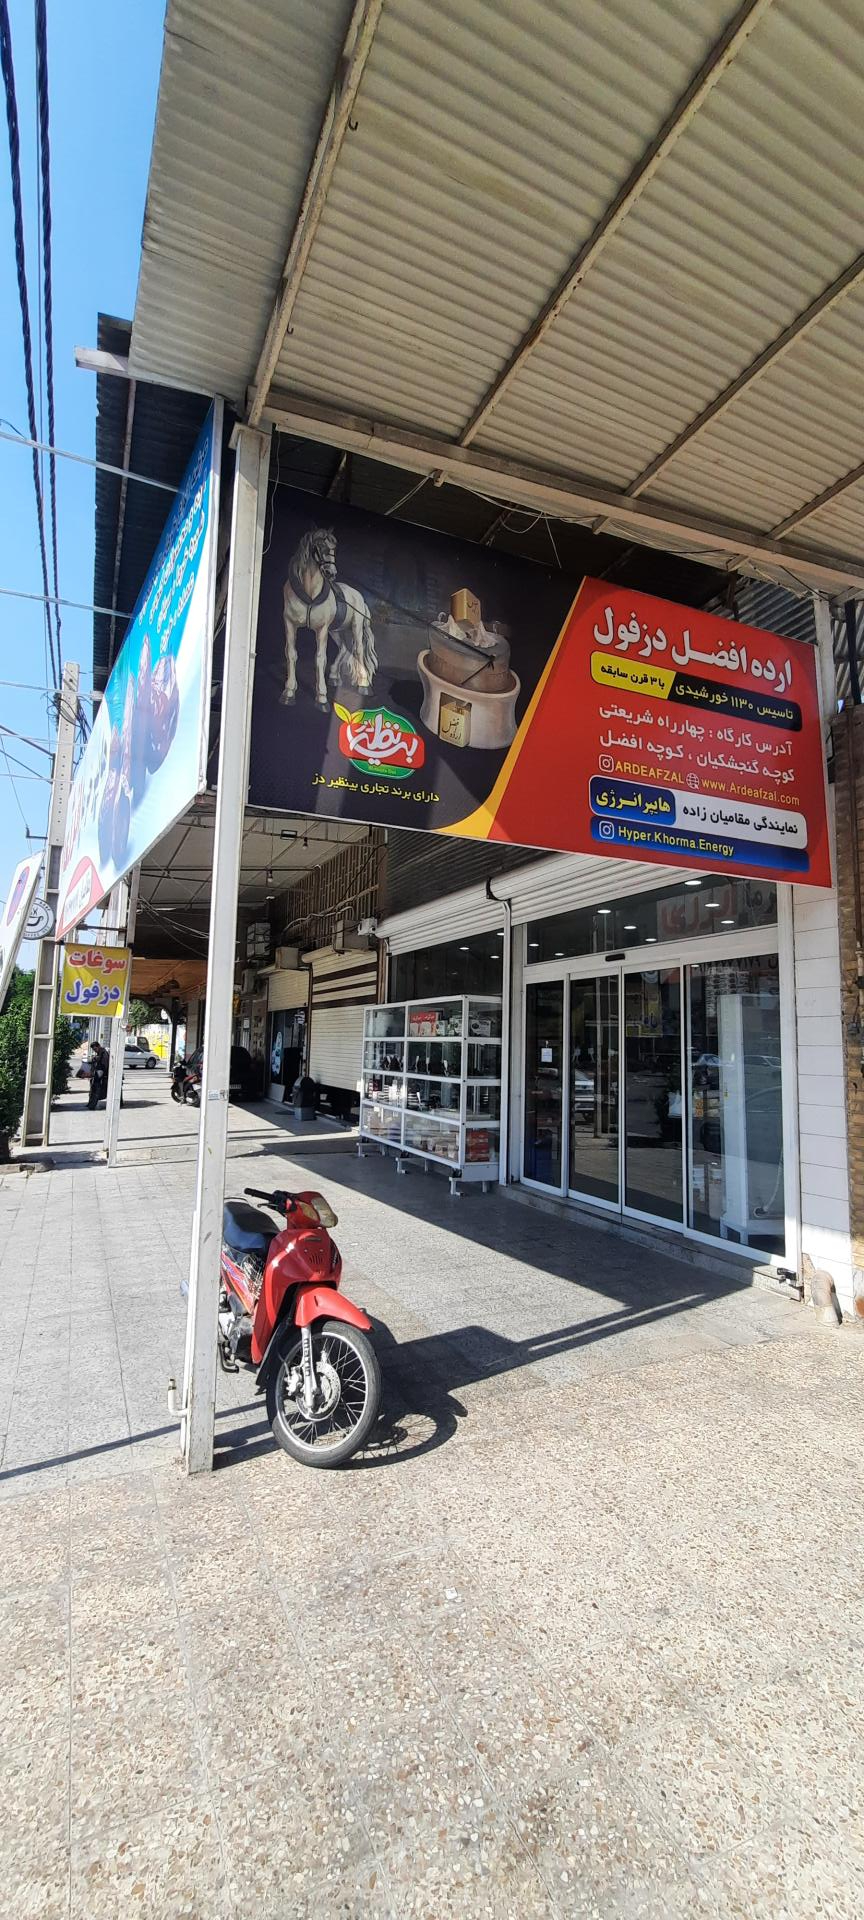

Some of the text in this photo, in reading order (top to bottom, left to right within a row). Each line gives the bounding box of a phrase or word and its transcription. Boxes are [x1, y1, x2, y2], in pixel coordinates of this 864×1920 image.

[593, 606, 792, 693] ارده افضل دزفول
[600, 664, 629, 679] سابقه
[630, 673, 649, 685] قرن
[675, 683, 794, 720] تاسیس ۱۱۳۰ خورشیدی
[599, 704, 654, 726] شریعتی
[600, 730, 643, 750] افضل
[717, 728, 753, 748] کارگاه
[646, 741, 684, 761] کوچه
[755, 740, 793, 757] آدرس
[615, 760, 685, 785] ARDEAFZAL
[696, 751, 759, 775] گنجشکیان
[312, 773, 326, 785] دز
[762, 768, 795, 786] کوچه
[360, 782, 390, 796] تجاری
[391, 786, 411, 800] برند
[413, 791, 440, 803] دارای
[701, 778, 800, 806] www.Ardeafzal.com
[682, 805, 799, 836] نمایندگی مقامیان زاده
[69, 950, 126, 974] سوغات
[66, 980, 120, 1005] دزفول
